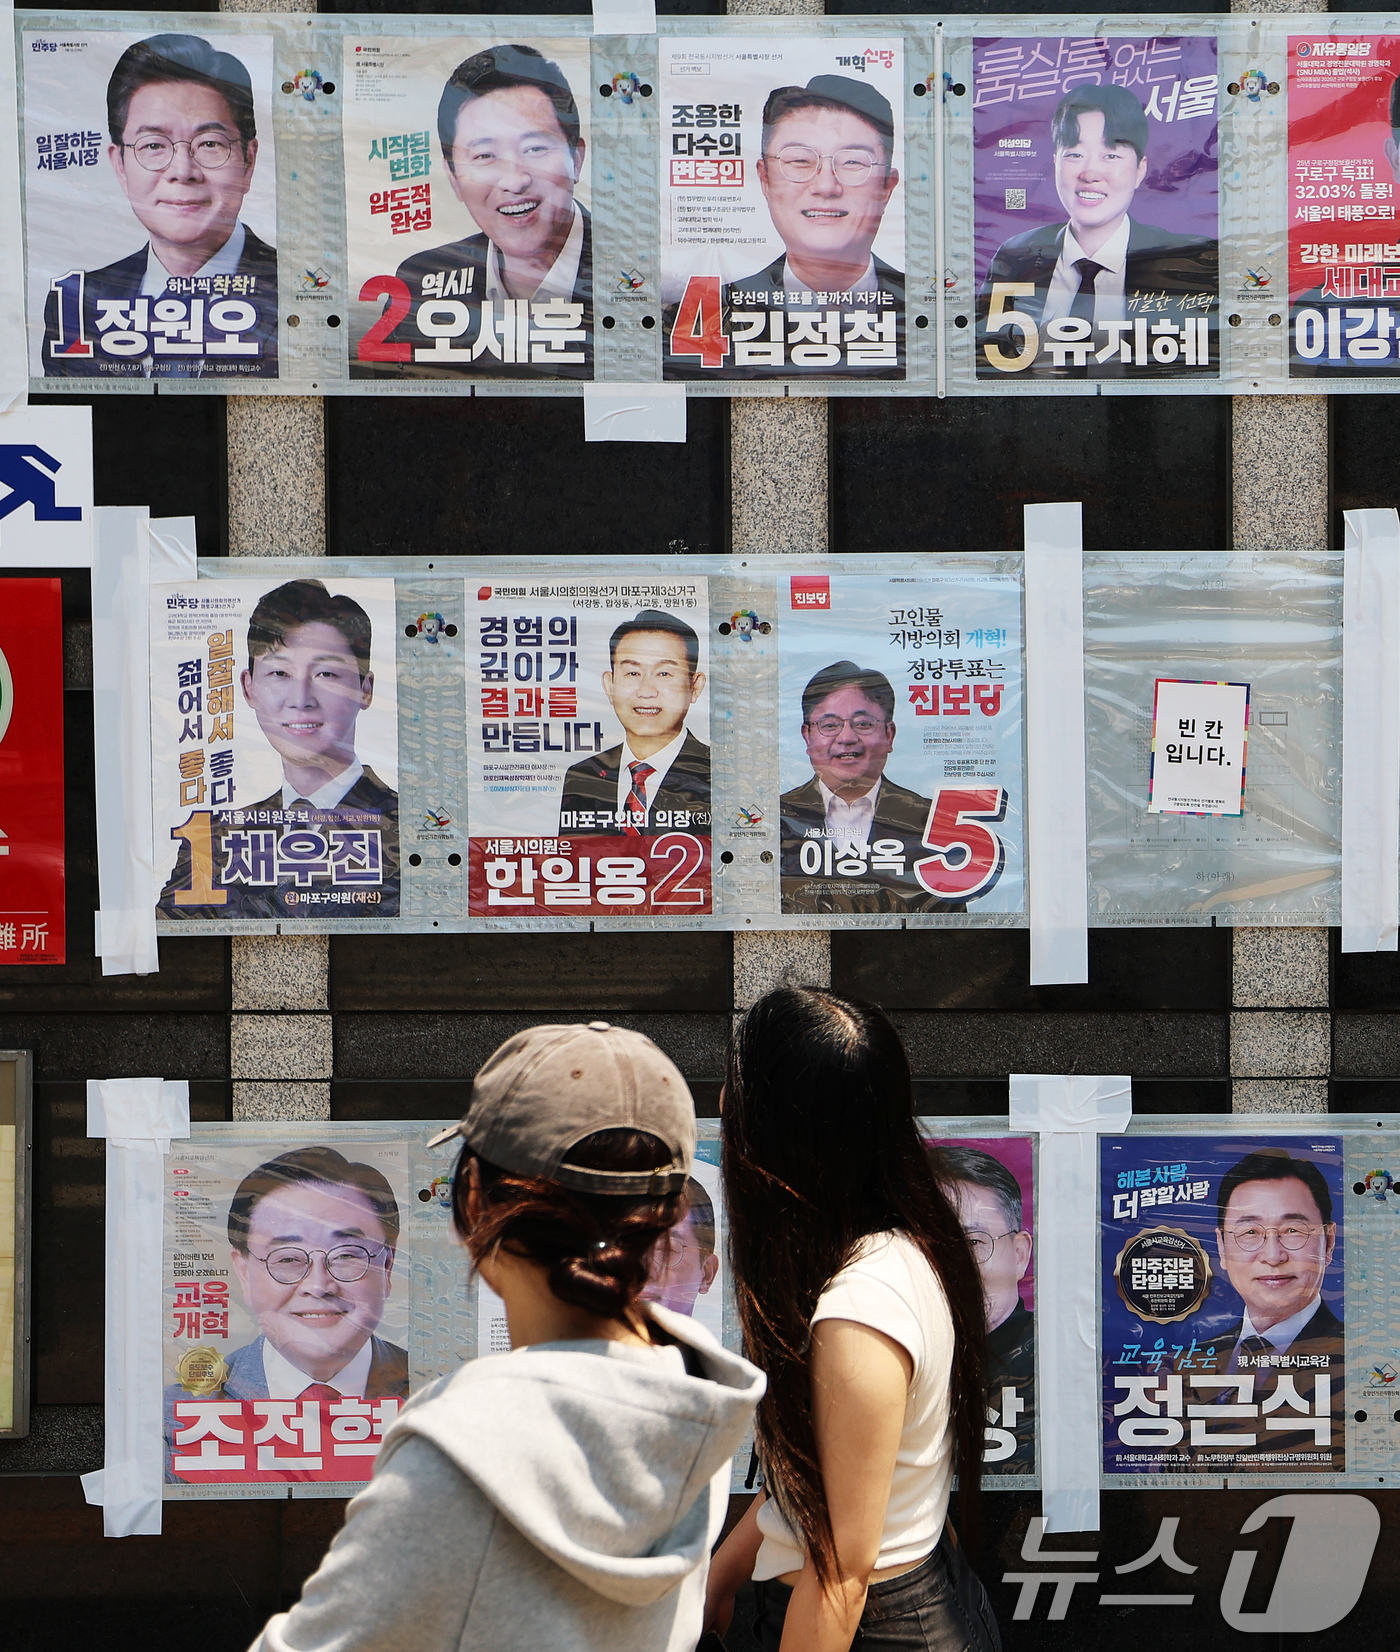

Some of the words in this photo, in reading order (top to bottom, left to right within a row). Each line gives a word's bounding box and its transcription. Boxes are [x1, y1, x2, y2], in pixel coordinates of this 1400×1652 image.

[32, 42, 57, 52] 민주당
[1312, 42, 1371, 56] 자유통일당
[835, 48, 895, 73] 개혁신당
[973, 37, 1109, 108] 룸살롱
[1114, 38, 1182, 88] 없는
[1144, 74, 1218, 123] 서울
[672, 104, 742, 128] 조용한
[369, 131, 430, 162] 시작된
[672, 133, 741, 157] 다수의
[999, 139, 1032, 148] 여성의당
[37, 148, 99, 171] 서울시장
[390, 158, 432, 182] 변화
[672, 161, 742, 185] 변호인
[1295, 166, 1338, 182] 구로구
[1340, 166, 1374, 182] 득표!
[369, 184, 431, 215] 압도적
[1295, 184, 1356, 199] 32.03%
[1360, 183, 1393, 199] 돌풍!
[391, 208, 432, 236] 완성
[1295, 205, 1335, 222] 서울의
[1338, 205, 1395, 221] 태풍으로!
[1300, 244, 1339, 264] 강한
[168, 278, 210, 294] 하나씩
[213, 276, 256, 296] 착착!
[421, 267, 475, 299] 역시!
[731, 290, 768, 306] 당신의
[772, 290, 786, 305] 한
[788, 290, 814, 305] 표를
[816, 290, 853, 305] 끝까지
[857, 290, 894, 305] 지키는
[1128, 290, 1173, 313] 유일한
[1176, 292, 1214, 314] 선택
[50, 270, 94, 358] 1
[358, 275, 411, 362] 2
[415, 298, 586, 364] 오세훈
[670, 276, 730, 368] 4
[95, 298, 259, 356] 정원오
[732, 310, 898, 366] 김정철
[984, 282, 1039, 372] 5
[1043, 317, 1209, 366] 유지혜
[1295, 308, 1400, 360] 이강
[494, 588, 526, 596] 국민의힘
[530, 586, 618, 597] 서울시의회의원선거
[621, 586, 696, 596] 마포구제3선거구
[1200, 579, 1228, 592] 상(위)
[167, 598, 199, 609] 민주당
[572, 599, 602, 608] (서강동,
[605, 599, 632, 608] 합정동,
[635, 599, 661, 608] 서교동,
[664, 599, 697, 608] 망원1동)
[795, 592, 827, 605] 진보당
[888, 608, 944, 626] 고인물
[480, 616, 578, 647] 경험의
[889, 629, 960, 649] 지방의회
[966, 628, 1006, 649] 개혁!
[480, 651, 579, 682] 깊이가
[906, 658, 1005, 680] 정당투표는
[178, 659, 202, 743] 젊어서
[481, 687, 578, 718] 결과를
[908, 684, 1004, 716] 진보당
[482, 722, 603, 753] 만듭니다
[1179, 719, 1195, 738] 빈
[1204, 720, 1223, 739] 칸
[1166, 744, 1231, 766] 입니다.
[179, 748, 207, 807] 좋다
[210, 749, 236, 806] 좋다
[220, 810, 309, 824] 서울시의원후보
[561, 810, 649, 828] 마포구의회
[655, 810, 712, 827] 의장(전)
[485, 839, 572, 856] 서울시의원은
[800, 838, 906, 876] 이상옥
[913, 784, 1009, 903] 5
[170, 810, 228, 907] 1
[221, 830, 383, 886] 채우진
[483, 857, 647, 906] 한일용
[650, 832, 704, 906] 2
[1196, 871, 1235, 882] 하(아래)
[300, 891, 381, 904] 마포구의원(재선)
[1117, 1168, 1151, 1189] 해본
[1152, 1163, 1189, 1183] 사람,
[1112, 1190, 1138, 1220] 더
[1140, 1186, 1174, 1208] 잘할
[1175, 1181, 1210, 1202] 사람
[1141, 1236, 1186, 1249] 서울시교육감선거
[1132, 1258, 1194, 1274] 민주진보
[1132, 1274, 1194, 1290] 단일후보
[173, 1281, 230, 1308] 교육
[173, 1311, 228, 1339] 개혁
[1112, 1338, 1217, 1372] 교육감은
[1238, 1356, 1248, 1367] 現
[1250, 1355, 1330, 1367] 서울특별시교육감
[1114, 1374, 1332, 1447] 정근식
[1123, 1454, 1153, 1462] 서울대학교
[1320, 1453, 1332, 1461] 위원
